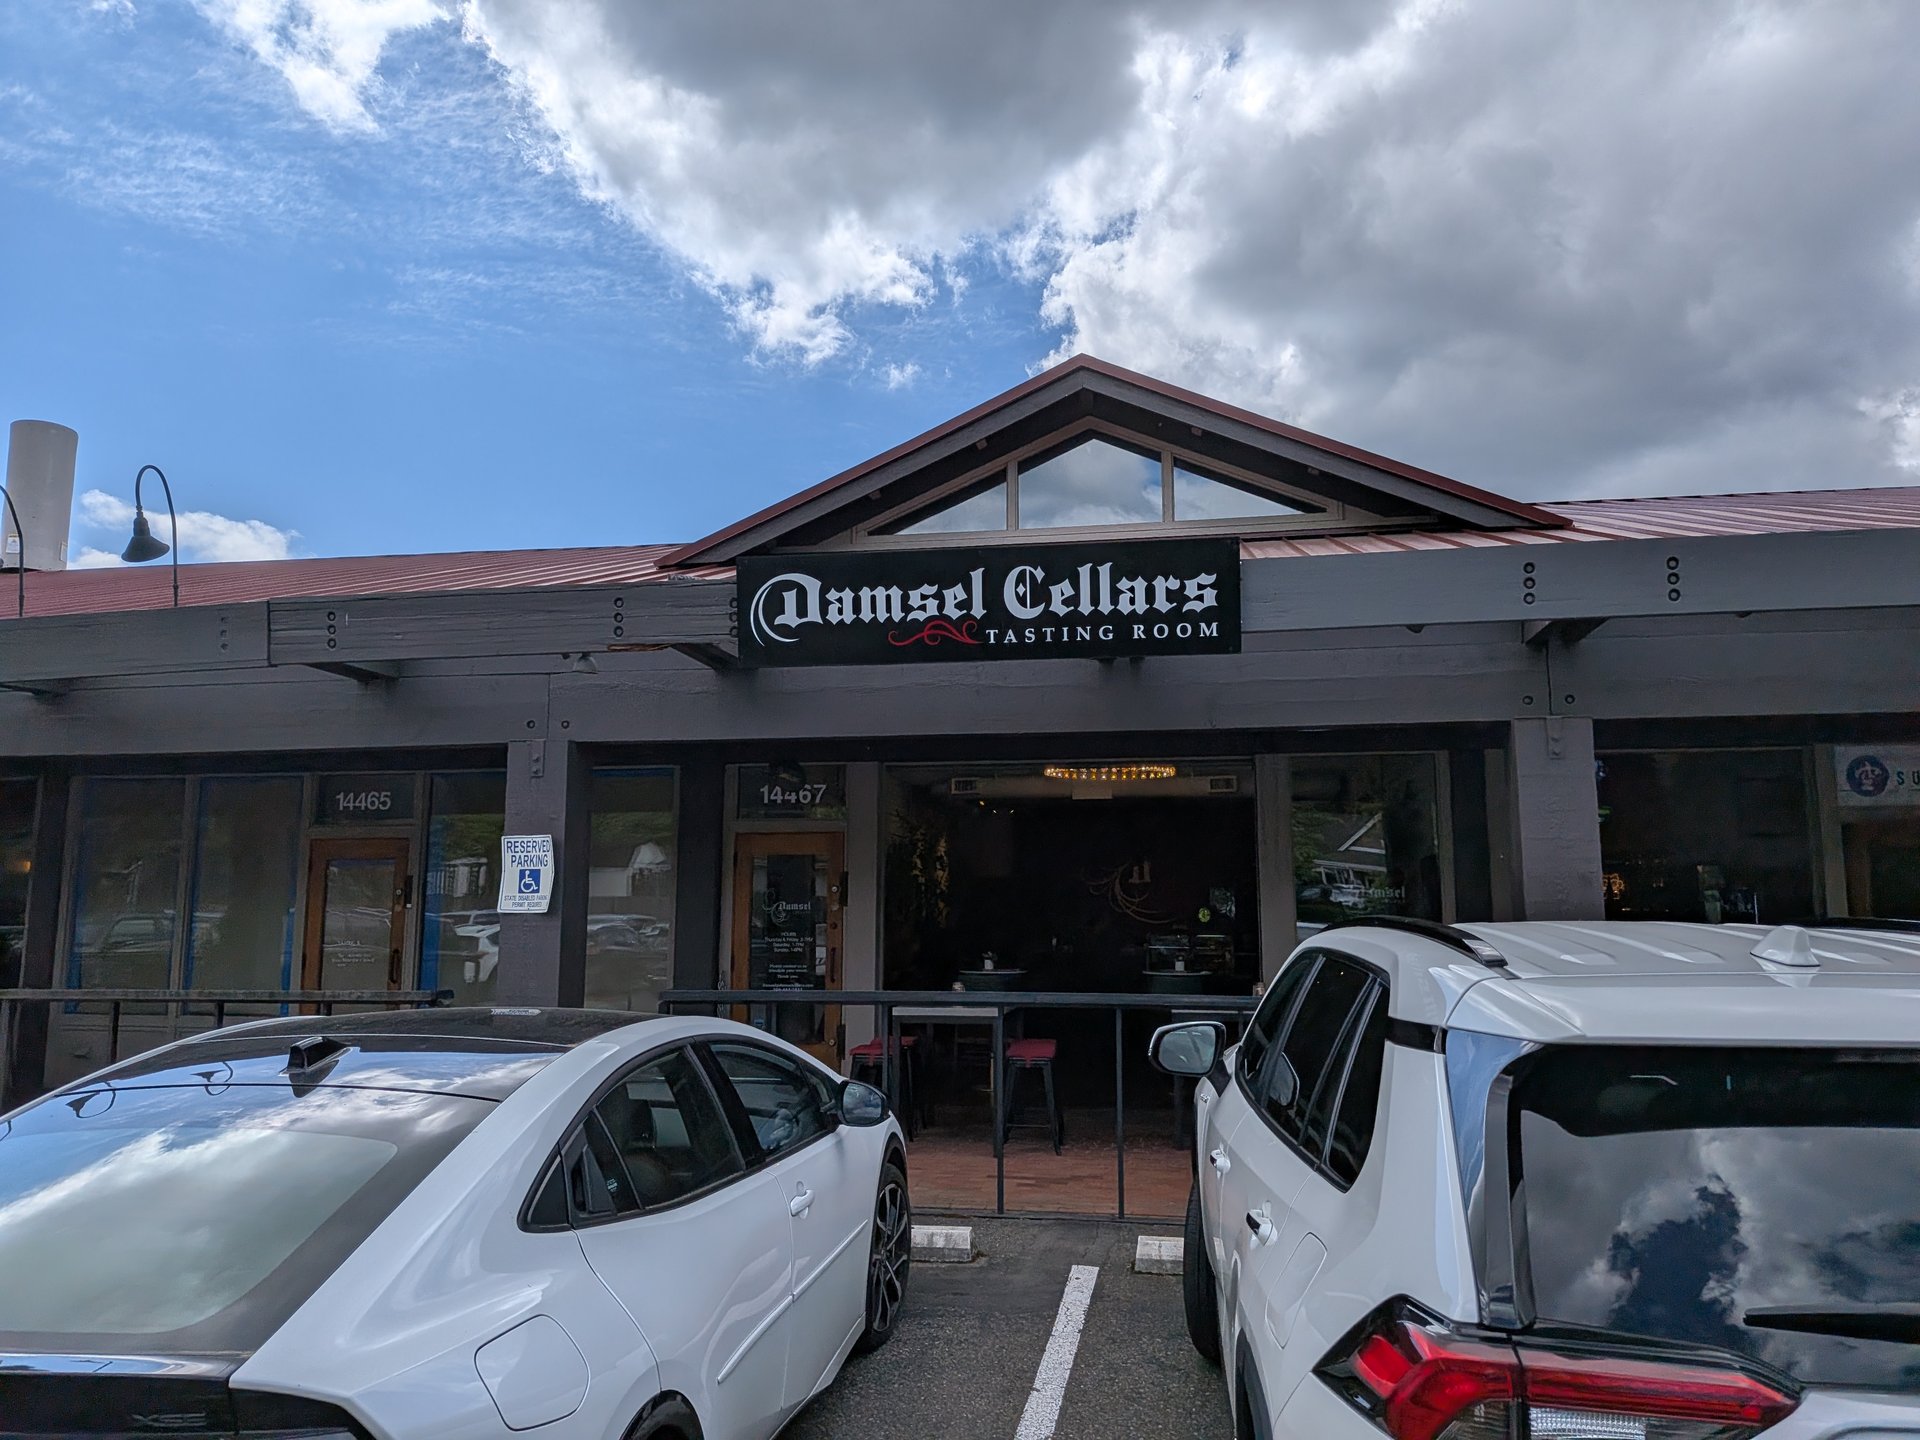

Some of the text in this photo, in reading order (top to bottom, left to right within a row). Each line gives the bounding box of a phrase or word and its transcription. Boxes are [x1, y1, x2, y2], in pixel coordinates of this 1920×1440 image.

[750, 561, 1219, 647] Damsel Cellars
[986, 621, 1220, 645] TASTING ROOM
[335, 791, 392, 811] 14465
[760, 783, 827, 804] 14467
[506, 839, 550, 854] RESERVED
[510, 854, 548, 868] PARKING
[131, 1412, 208, 1427] XSE
